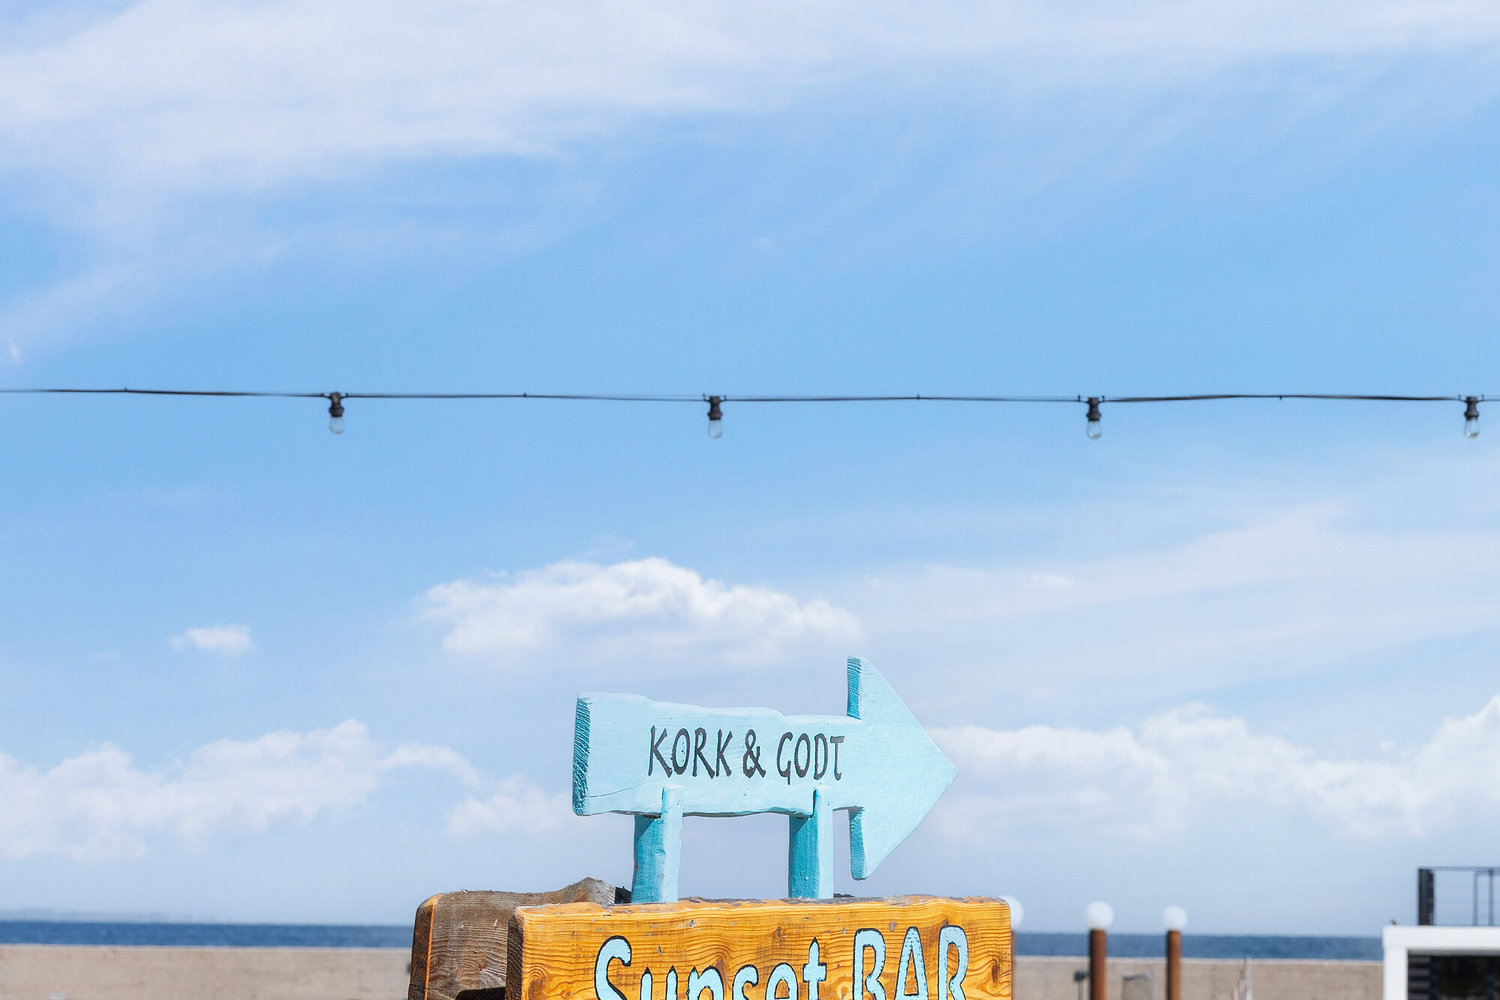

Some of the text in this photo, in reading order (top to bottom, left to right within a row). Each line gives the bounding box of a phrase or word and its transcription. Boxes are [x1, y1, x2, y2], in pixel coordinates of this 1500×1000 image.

[648, 725, 845, 784] KORK & GODT
